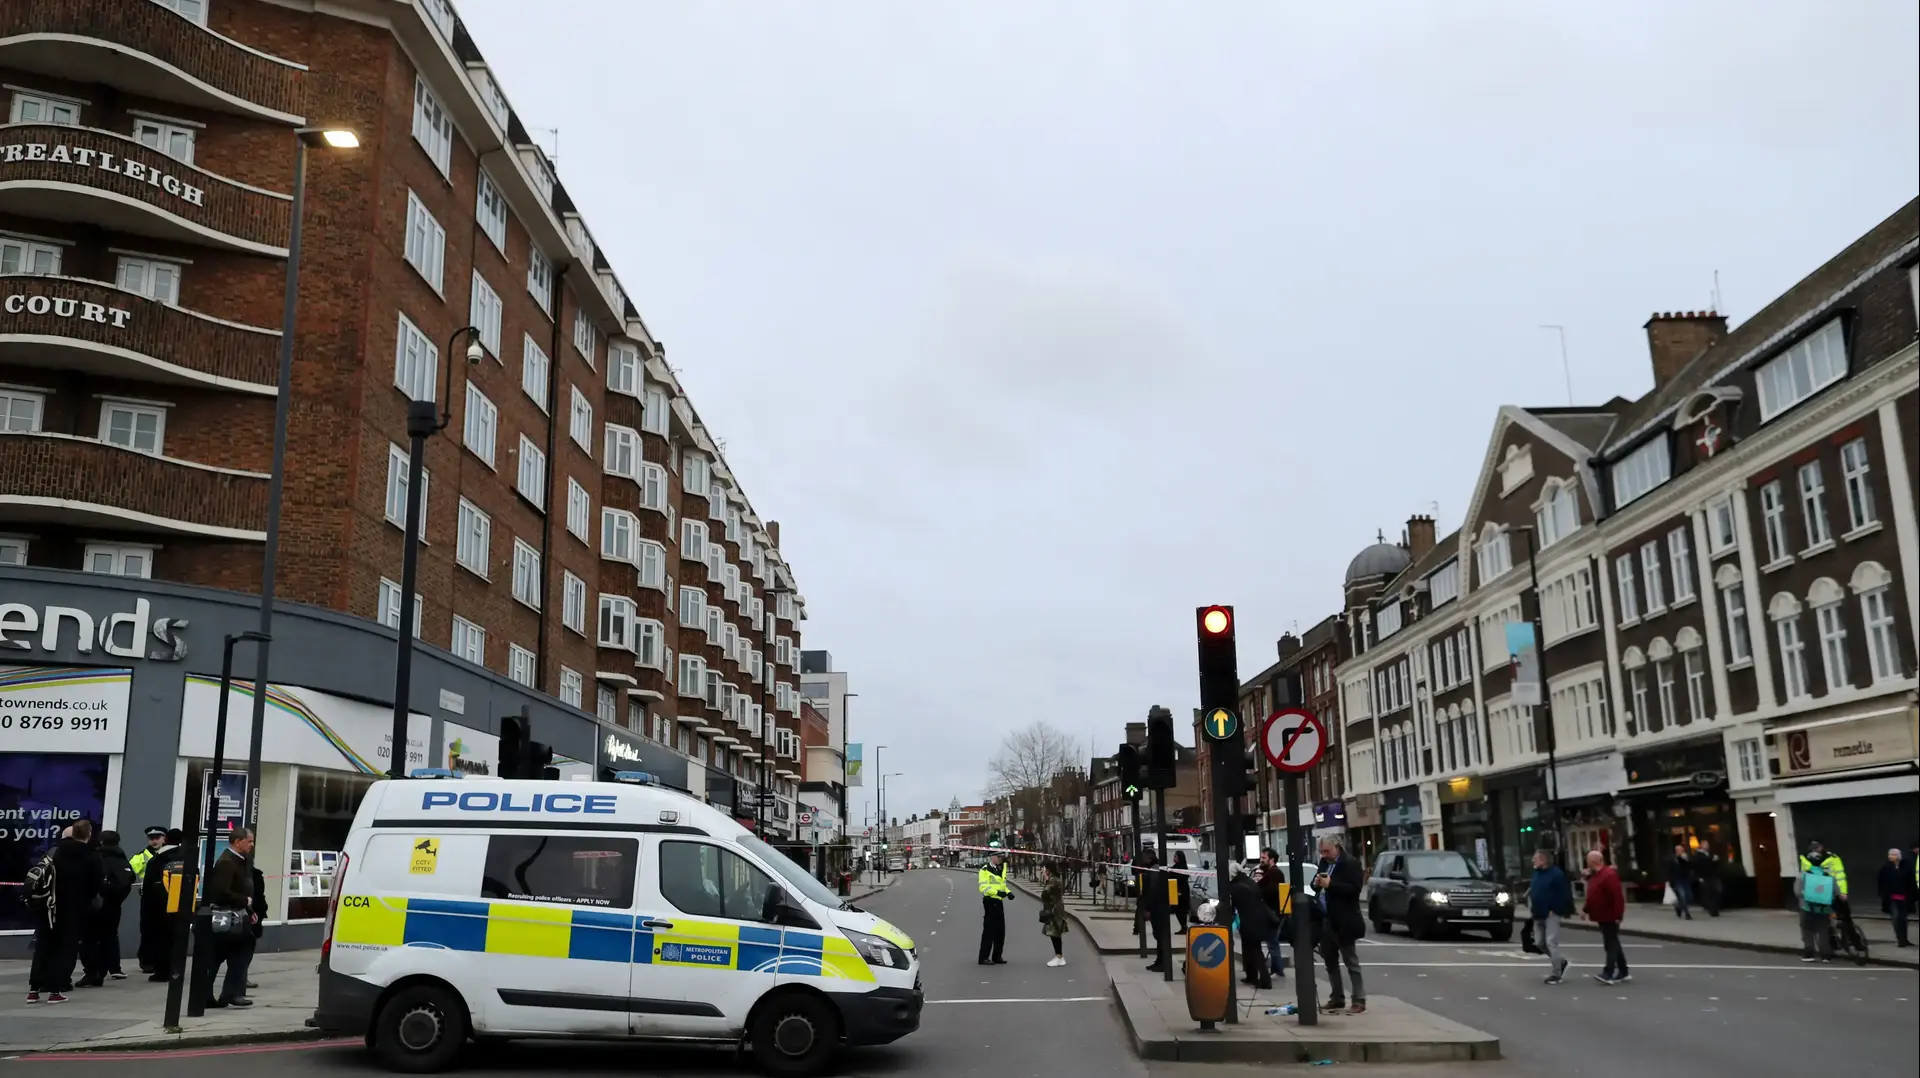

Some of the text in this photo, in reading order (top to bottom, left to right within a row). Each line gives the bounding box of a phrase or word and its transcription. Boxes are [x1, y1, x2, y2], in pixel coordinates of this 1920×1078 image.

[0, 143, 204, 207] REATLEIGH
[5, 294, 131, 328] COURT
[0, 597, 189, 662] ends
[0, 697, 108, 711] townends.co.uk
[0, 715, 108, 731] 0 8769 9911
[377, 746, 391, 759] 020
[409, 751, 424, 764] 9911
[422, 791, 618, 814] POLICE
[0, 806, 81, 820] ent value
[14, 825, 61, 842] you?
[343, 896, 370, 908] CCA
